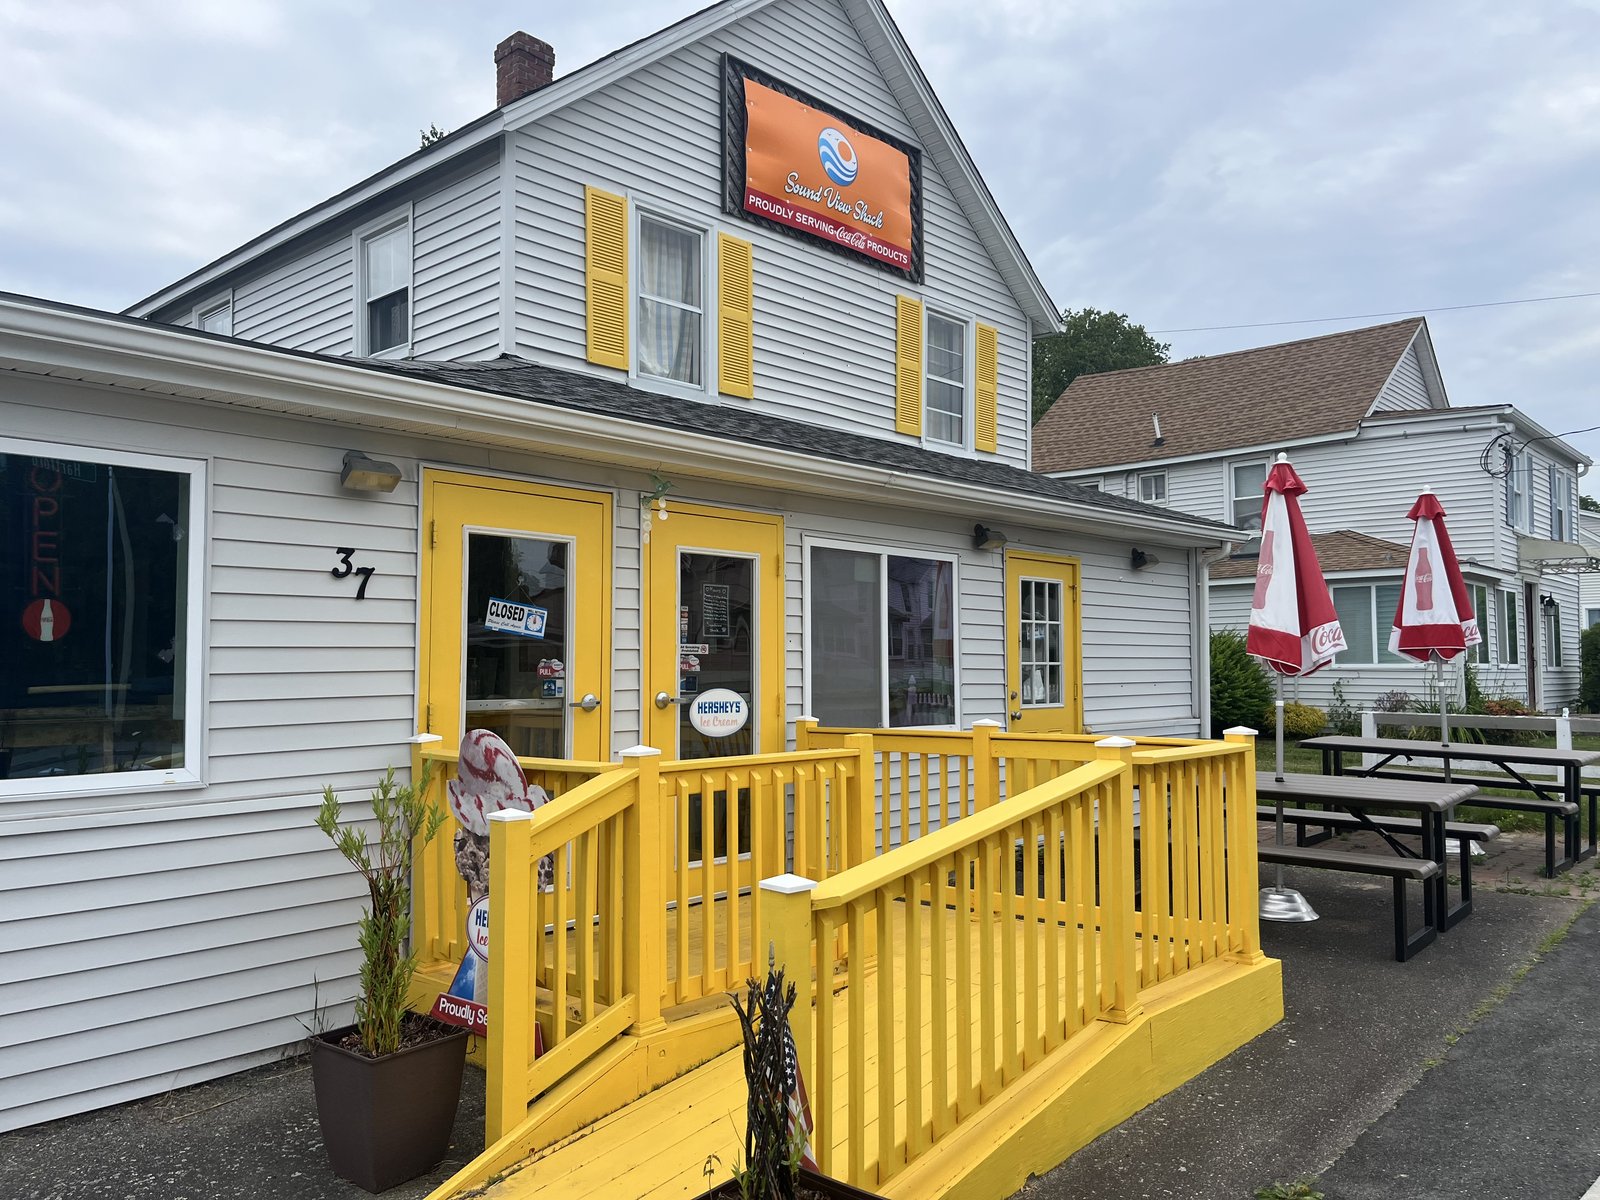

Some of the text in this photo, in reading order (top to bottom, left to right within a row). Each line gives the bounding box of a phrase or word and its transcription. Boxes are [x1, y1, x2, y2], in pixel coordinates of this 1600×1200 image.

[784, 171, 884, 229] Sound View Shack
[749, 195, 794, 220] PROUDLY
[795, 212, 834, 234] SERVING
[866, 240, 908, 264] PRODUCTS
[31, 465, 62, 597] OPEN
[331, 547, 376, 600] 37
[489, 601, 525, 622] CLOSED
[1312, 626, 1344, 655] Coca
[539, 668, 552, 676] PULL
[697, 701, 741, 714] HERSHEY'S
[700, 715, 738, 727] Ice Cream
[439, 998, 476, 1026] Proudly
